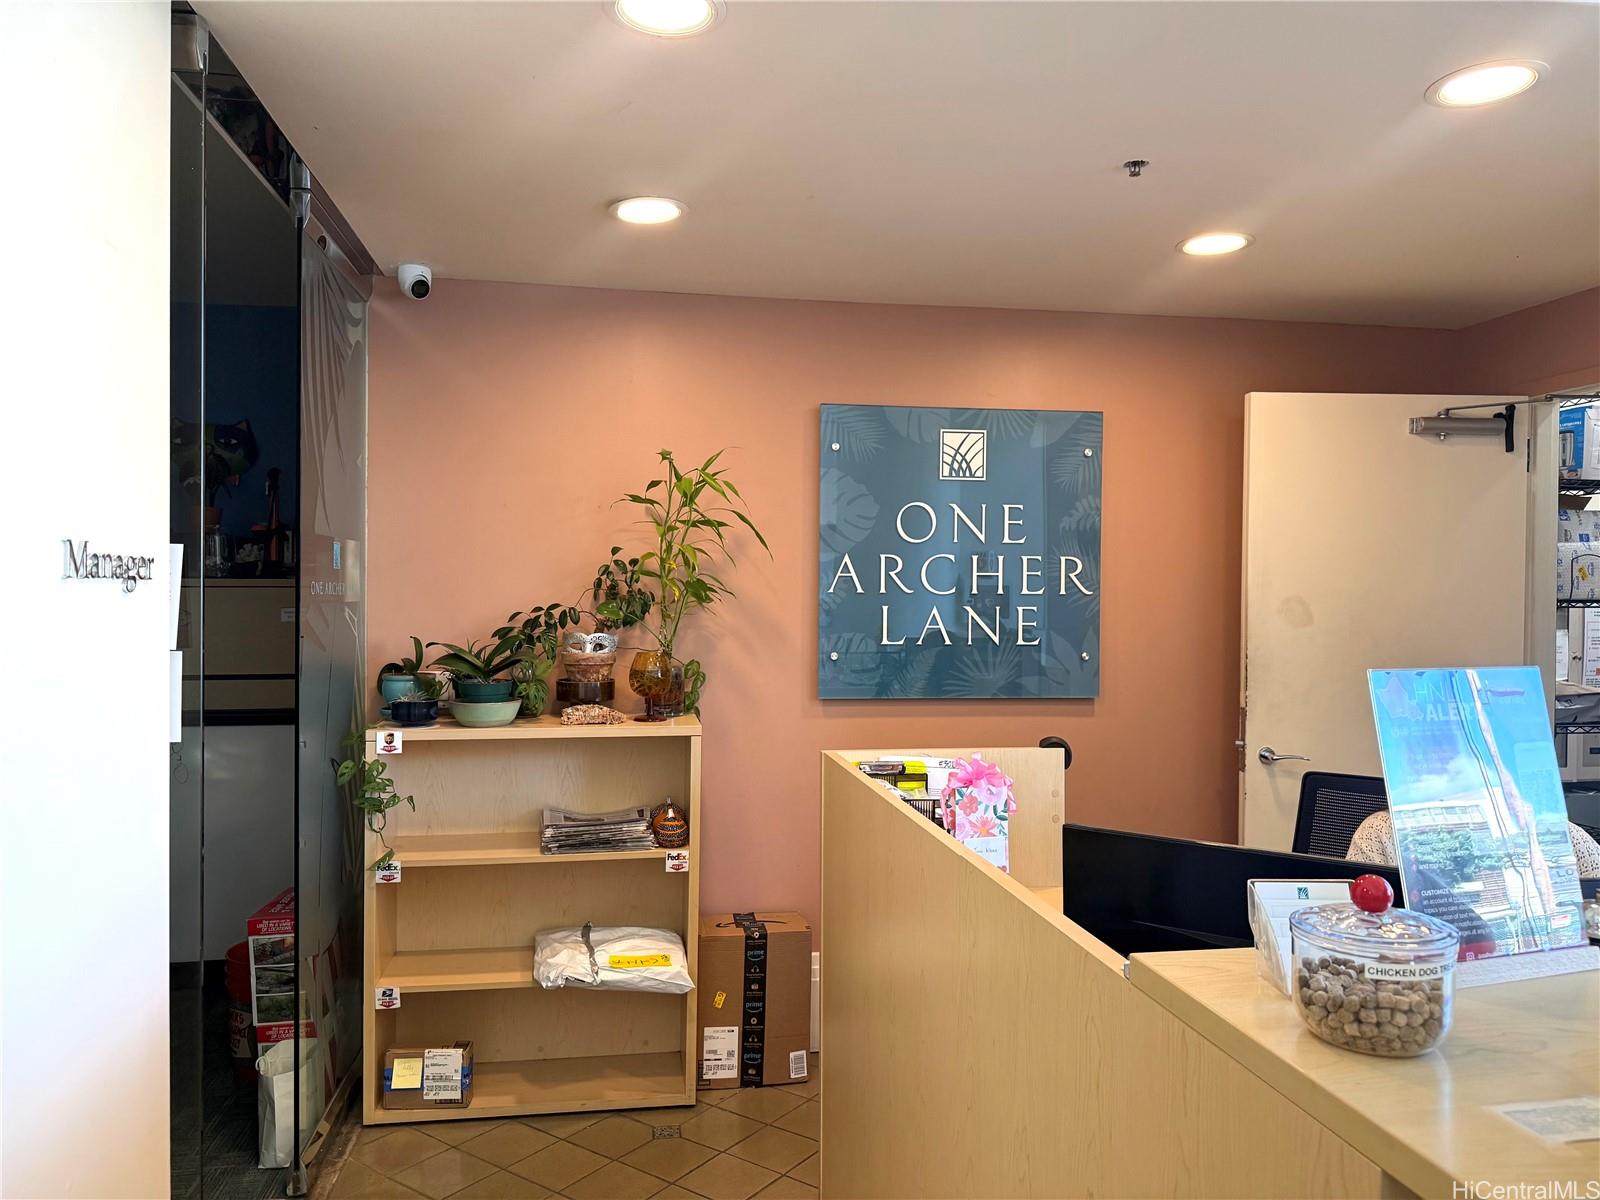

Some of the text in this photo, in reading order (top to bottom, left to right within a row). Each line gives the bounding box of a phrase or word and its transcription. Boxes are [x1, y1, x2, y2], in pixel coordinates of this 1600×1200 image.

[896, 501, 1027, 544] ONE
[61, 539, 154, 593] Manager
[827, 553, 1094, 595] ARCHER
[310, 581, 323, 595] ONE
[880, 605, 1041, 646] LANE
[667, 853, 687, 861] FedEx
[1367, 966, 1416, 977] CHICKEN
[1418, 966, 1438, 977] DOG
